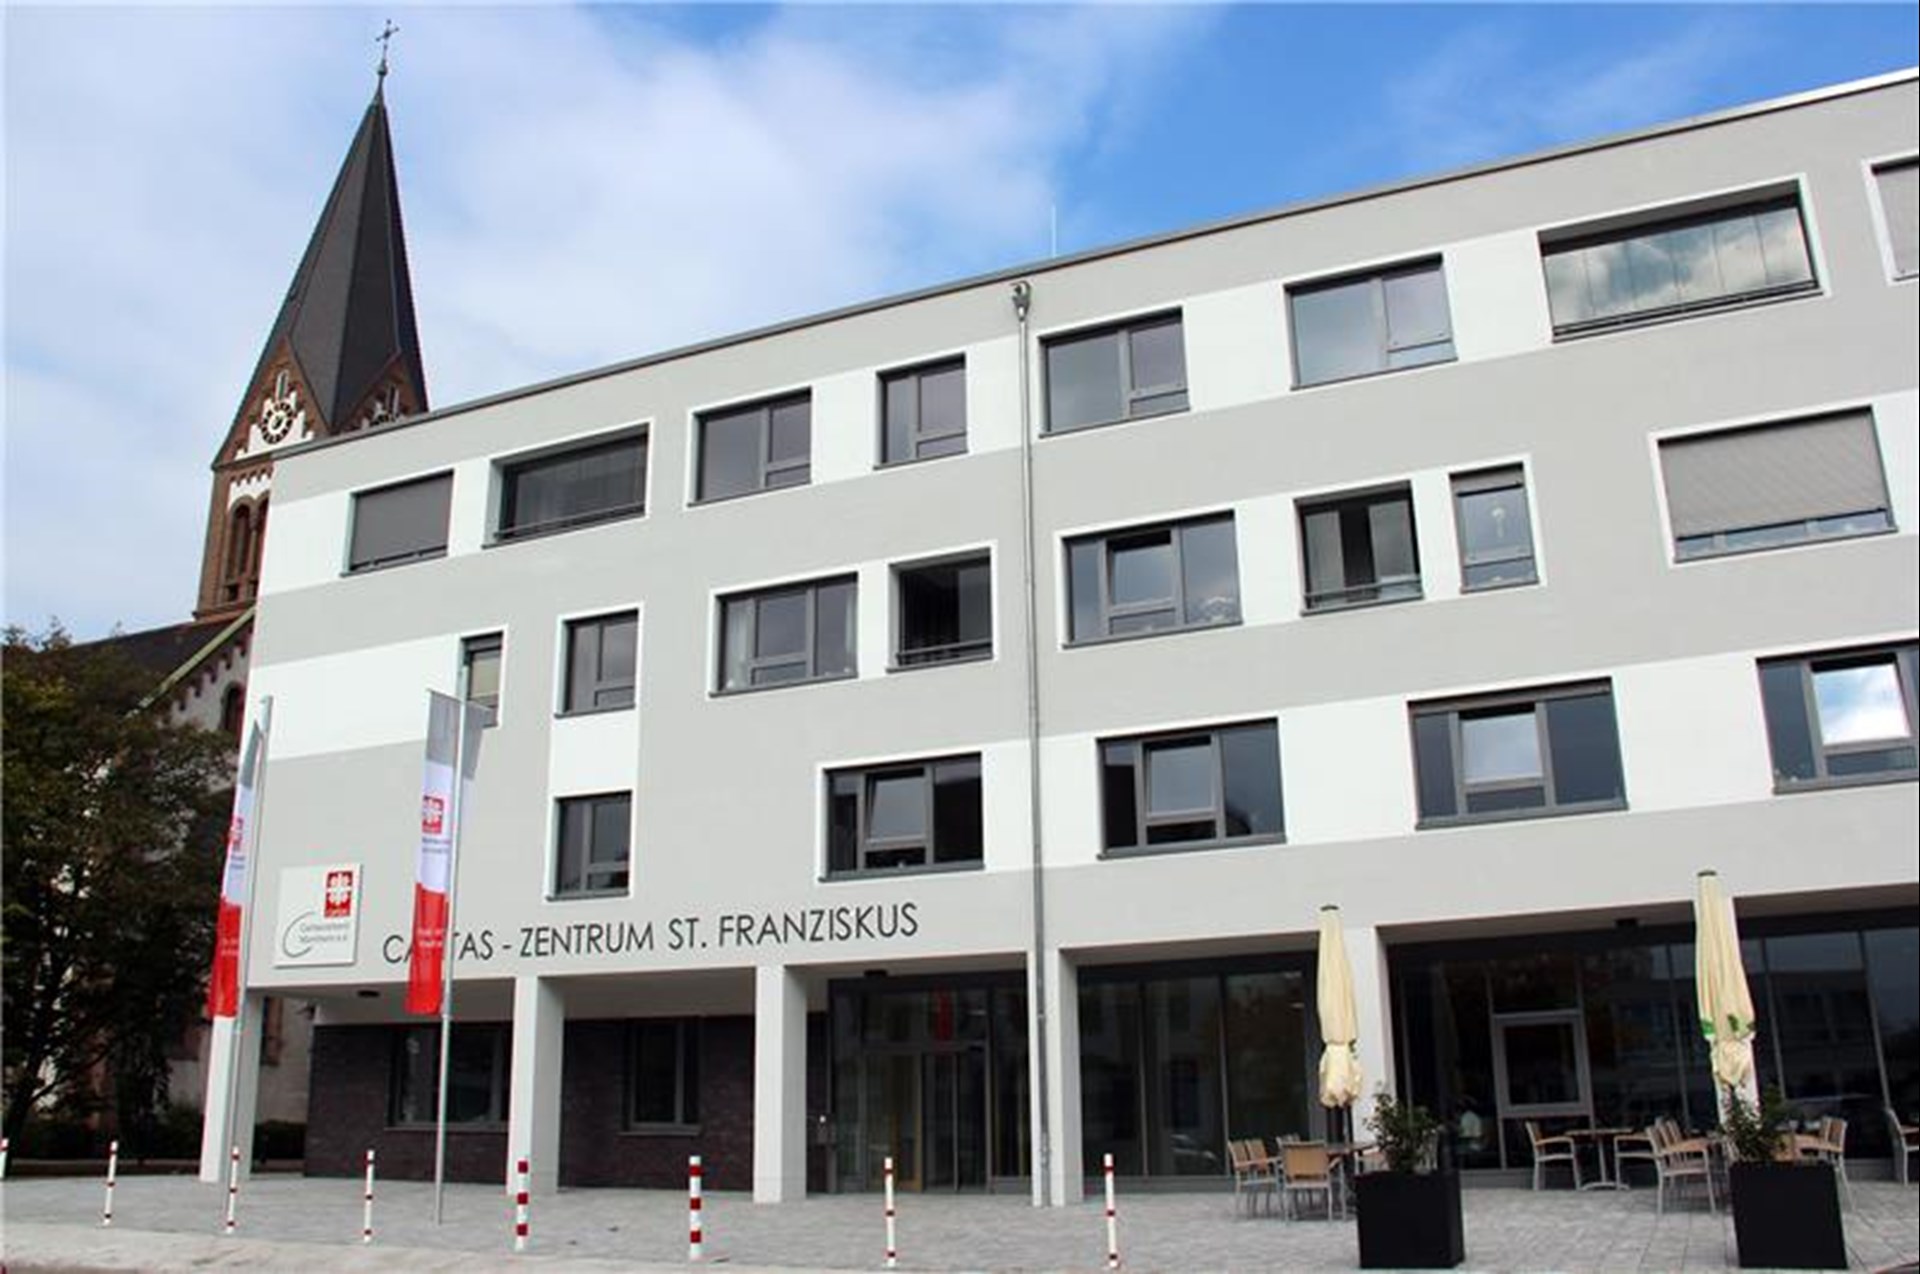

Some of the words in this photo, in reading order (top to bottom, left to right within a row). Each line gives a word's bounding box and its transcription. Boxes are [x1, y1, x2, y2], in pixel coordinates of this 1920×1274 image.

[519, 920, 654, 957] ZENTRUM
[668, 917, 707, 951] ST.
[718, 902, 919, 947] FRANZISKUS
